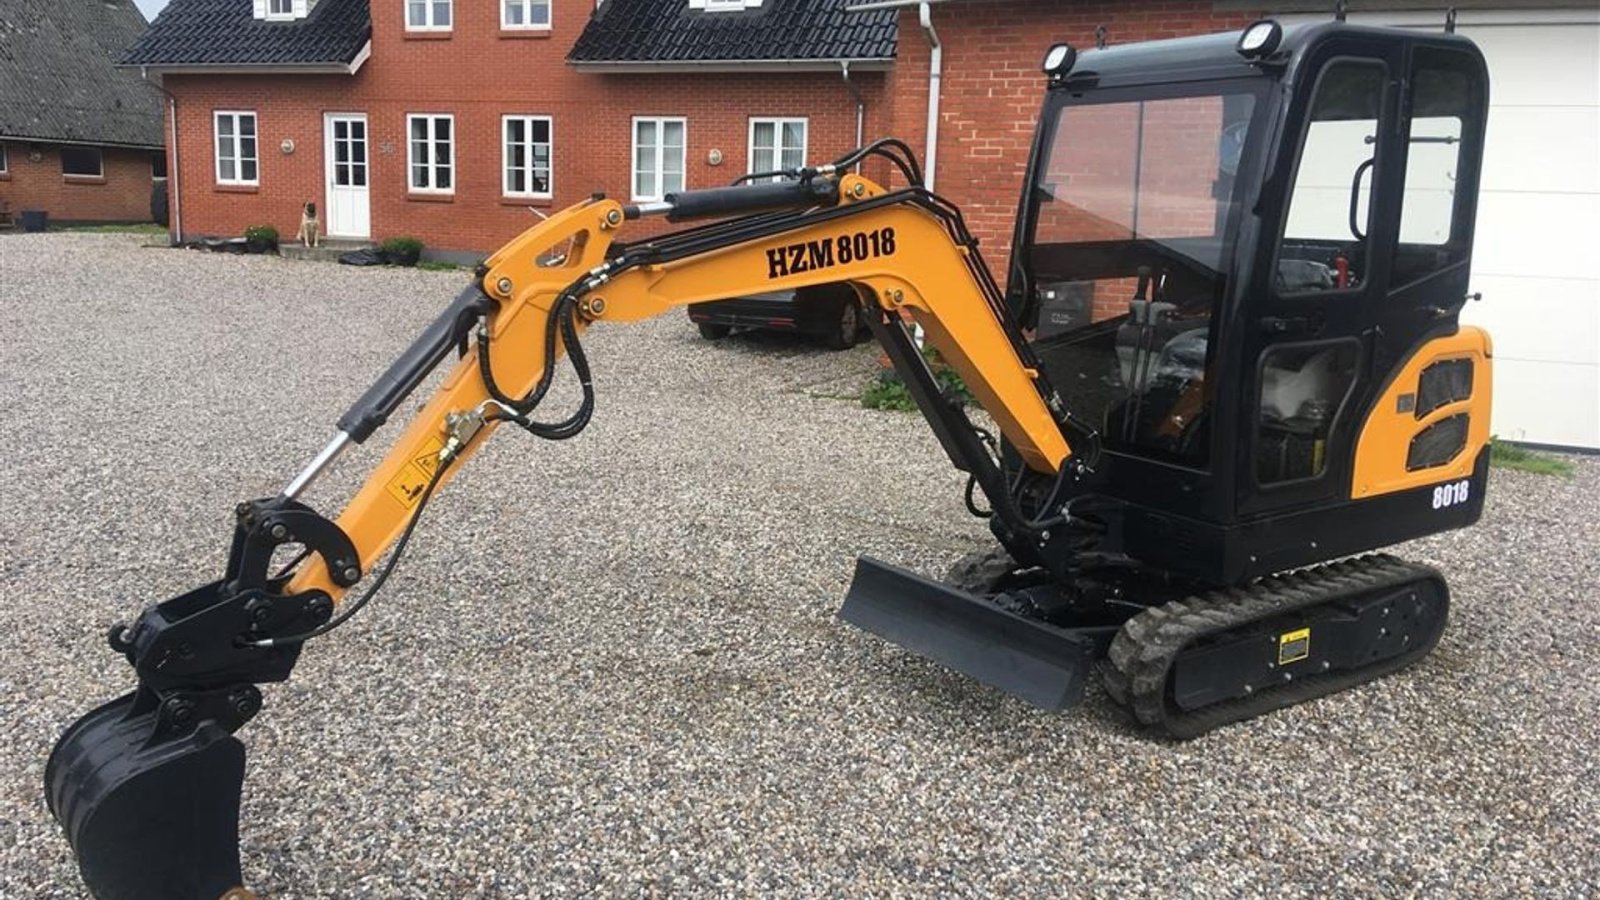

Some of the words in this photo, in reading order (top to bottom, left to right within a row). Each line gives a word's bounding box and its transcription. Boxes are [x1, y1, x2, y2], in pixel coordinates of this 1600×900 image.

[766, 238, 835, 279] HZM
[837, 227, 896, 264] 8018
[1432, 480, 1470, 509] 8018
